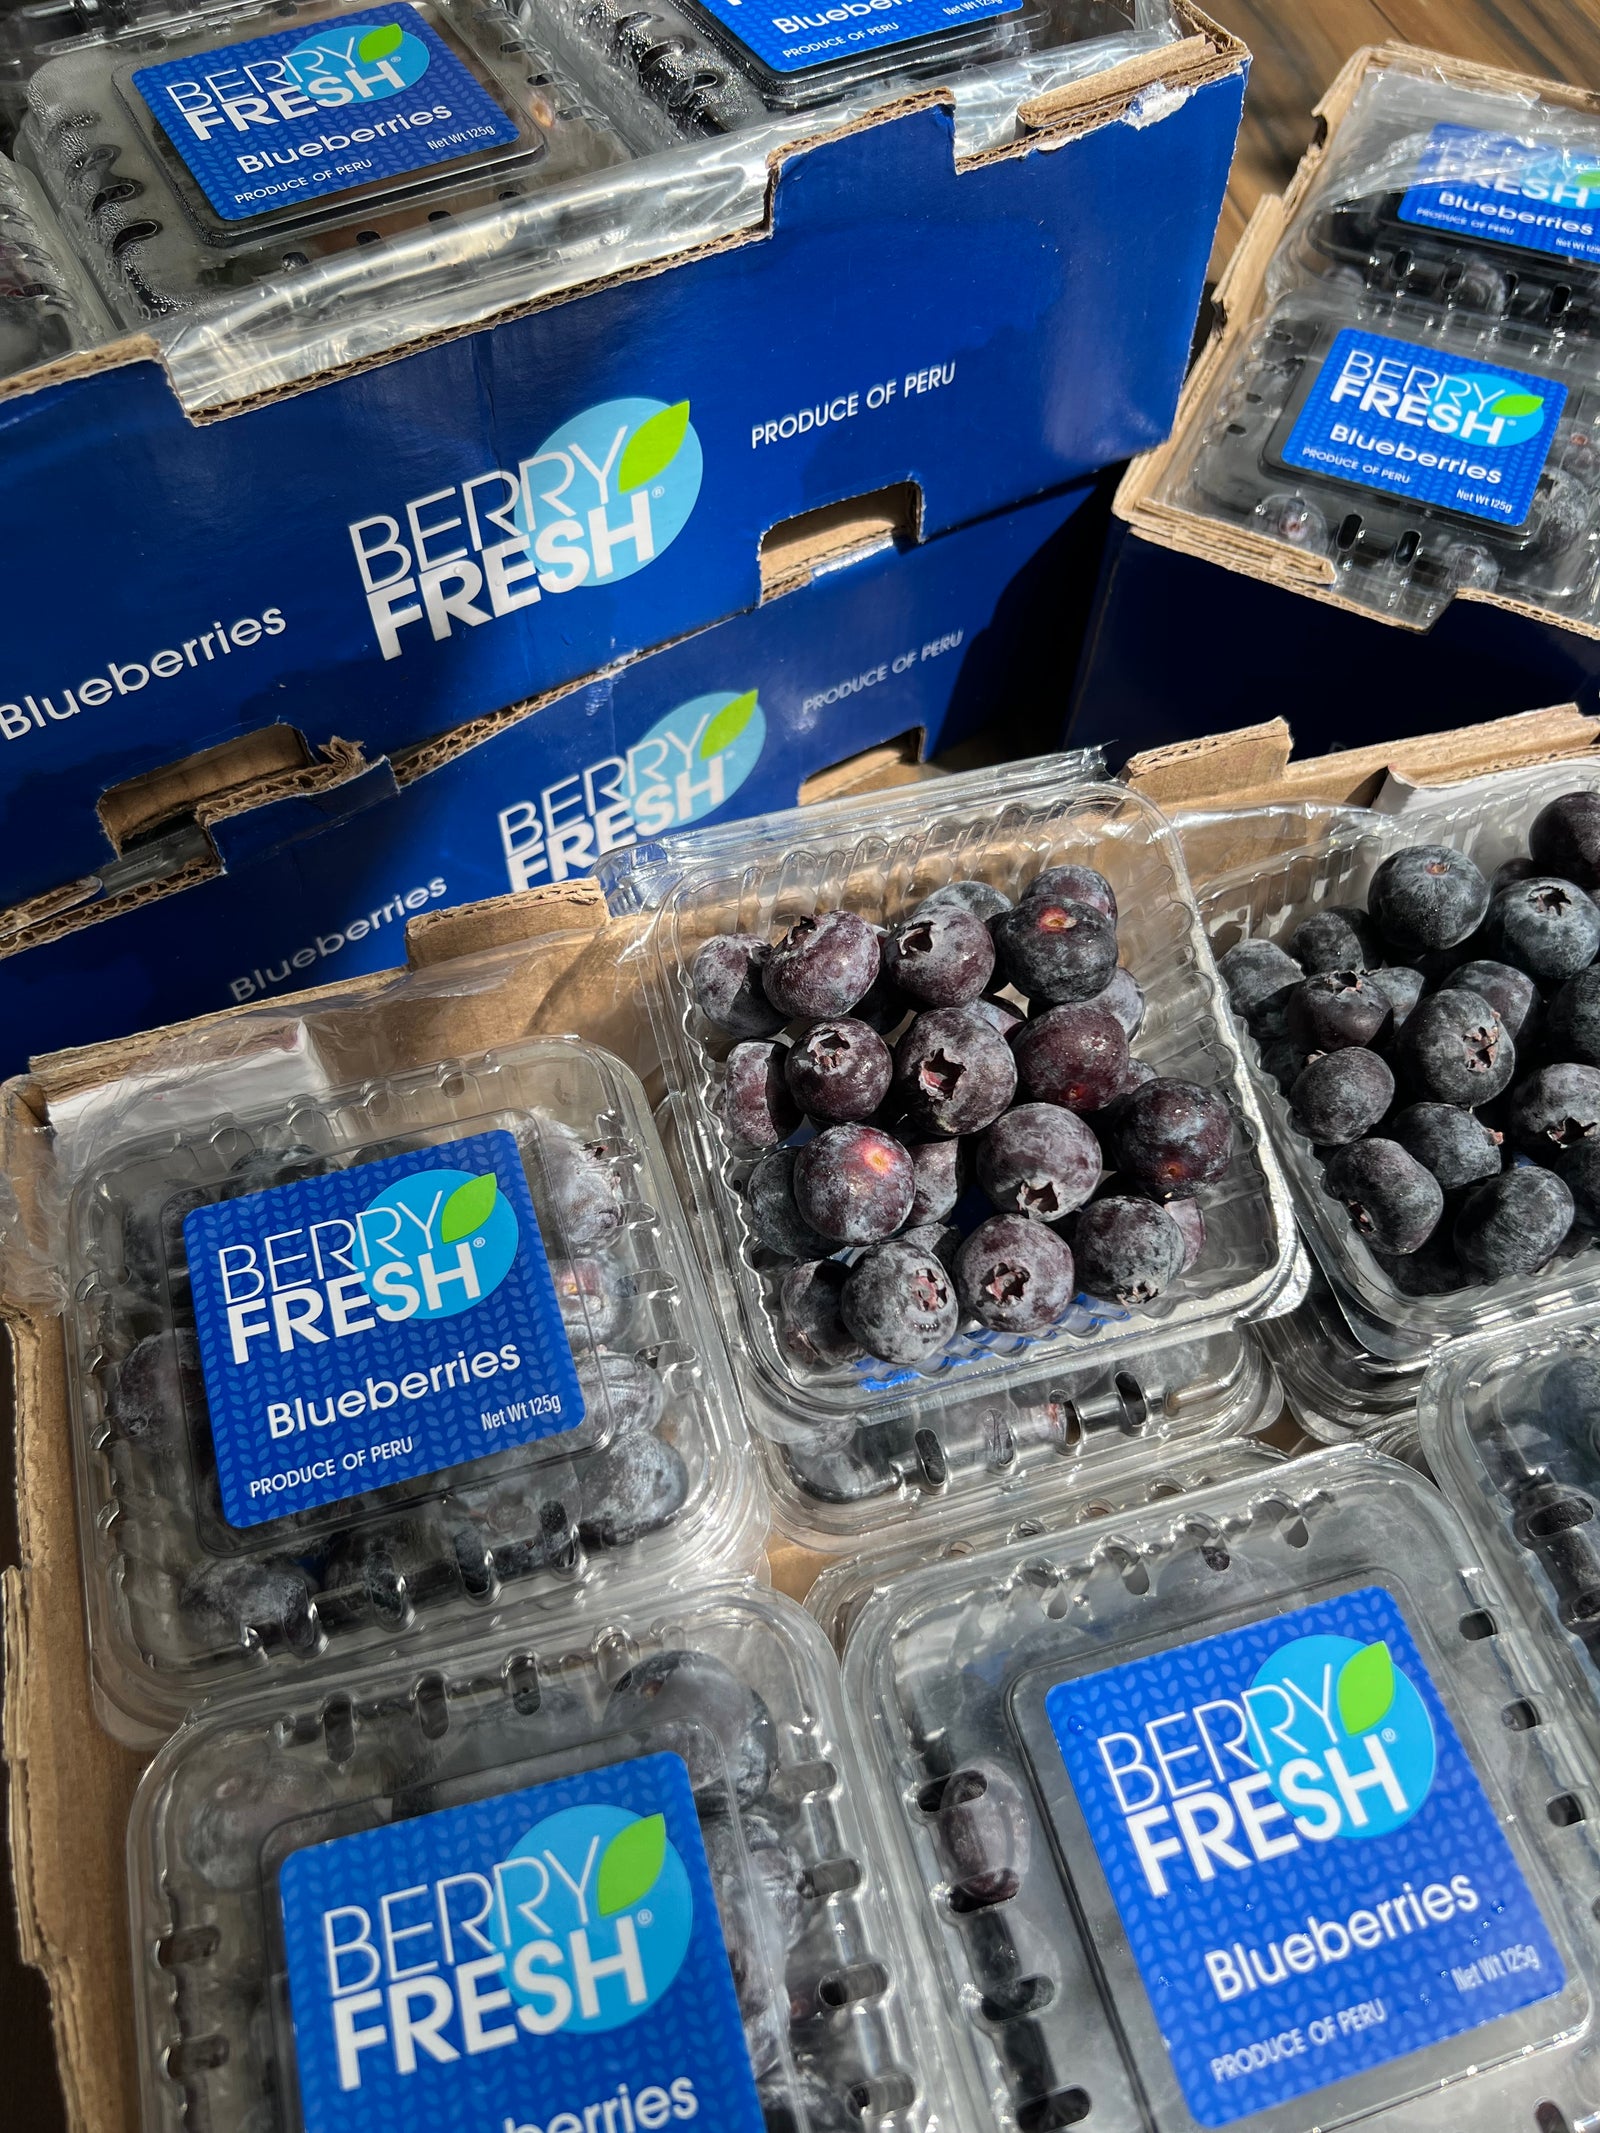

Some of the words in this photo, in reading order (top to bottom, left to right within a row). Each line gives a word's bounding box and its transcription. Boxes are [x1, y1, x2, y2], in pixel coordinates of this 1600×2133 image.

[782, 37, 846, 58] PRODUCE
[848, 30, 866, 41] OF
[867, 22, 899, 36] PERU
[942, 4, 961, 16] Net
[165, 36, 355, 113] BERRY
[183, 61, 406, 141] FRESH
[236, 103, 453, 174] Blueberries
[426, 136, 449, 151] Net
[449, 131, 467, 145] Wt
[466, 125, 495, 141] 125g
[234, 177, 307, 204] PRODUCE
[312, 169, 334, 183] OF
[336, 159, 372, 177] PERU
[1416, 207, 1467, 226] PRODUCE
[1470, 219, 1486, 230] OF
[1438, 191, 1594, 236] Blueberries
[752, 391, 859, 449] PRODUCE
[866, 379, 897, 409] OF
[904, 359, 956, 398] PERU
[1330, 375, 1506, 445] FRESH
[1341, 349, 1506, 412] BERRY
[1302, 446, 1359, 471] PRODUCE
[1362, 462, 1380, 476] OF
[1381, 468, 1411, 484] PERU
[1329, 424, 1503, 484] Blueberries
[348, 425, 628, 594] BERRY
[1456, 488, 1474, 503] Net
[1475, 493, 1490, 507] Wt
[1490, 498, 1513, 514] 125g
[365, 491, 655, 660] FRESH
[0, 607, 286, 740] Blueberries
[802, 664, 889, 715] PRODUCE
[892, 650, 918, 673] OF
[920, 628, 964, 662] PERU
[498, 713, 709, 857] BERRY
[507, 756, 725, 893] FRESH
[228, 876, 448, 1002] Blueberries
[217, 1190, 444, 1305] BERRY
[226, 1242, 481, 1365] FRESH
[267, 1344, 521, 1440] Blueberries
[481, 1410, 506, 1432] Net
[506, 1403, 529, 1422] Wt
[529, 1394, 562, 1415] 125g
[249, 1459, 336, 1498] PRODUCE
[342, 1450, 367, 1471] OF
[370, 1436, 414, 1463] PERU
[1097, 1664, 1339, 1814] BERRY
[1126, 1734, 1408, 1898] FRESH
[323, 1834, 599, 1999] BERRY
[1204, 1874, 1479, 2002] Blueberries
[332, 1915, 647, 2092] FRESH
[1451, 1963, 1484, 1992] Net
[1482, 1955, 1506, 1982] Wt
[1501, 1944, 1541, 1974] 125g
[1210, 2027, 1306, 2084] PRODUCE
[1308, 2015, 1337, 2046] OF
[1337, 1998, 1387, 2034] PERU
